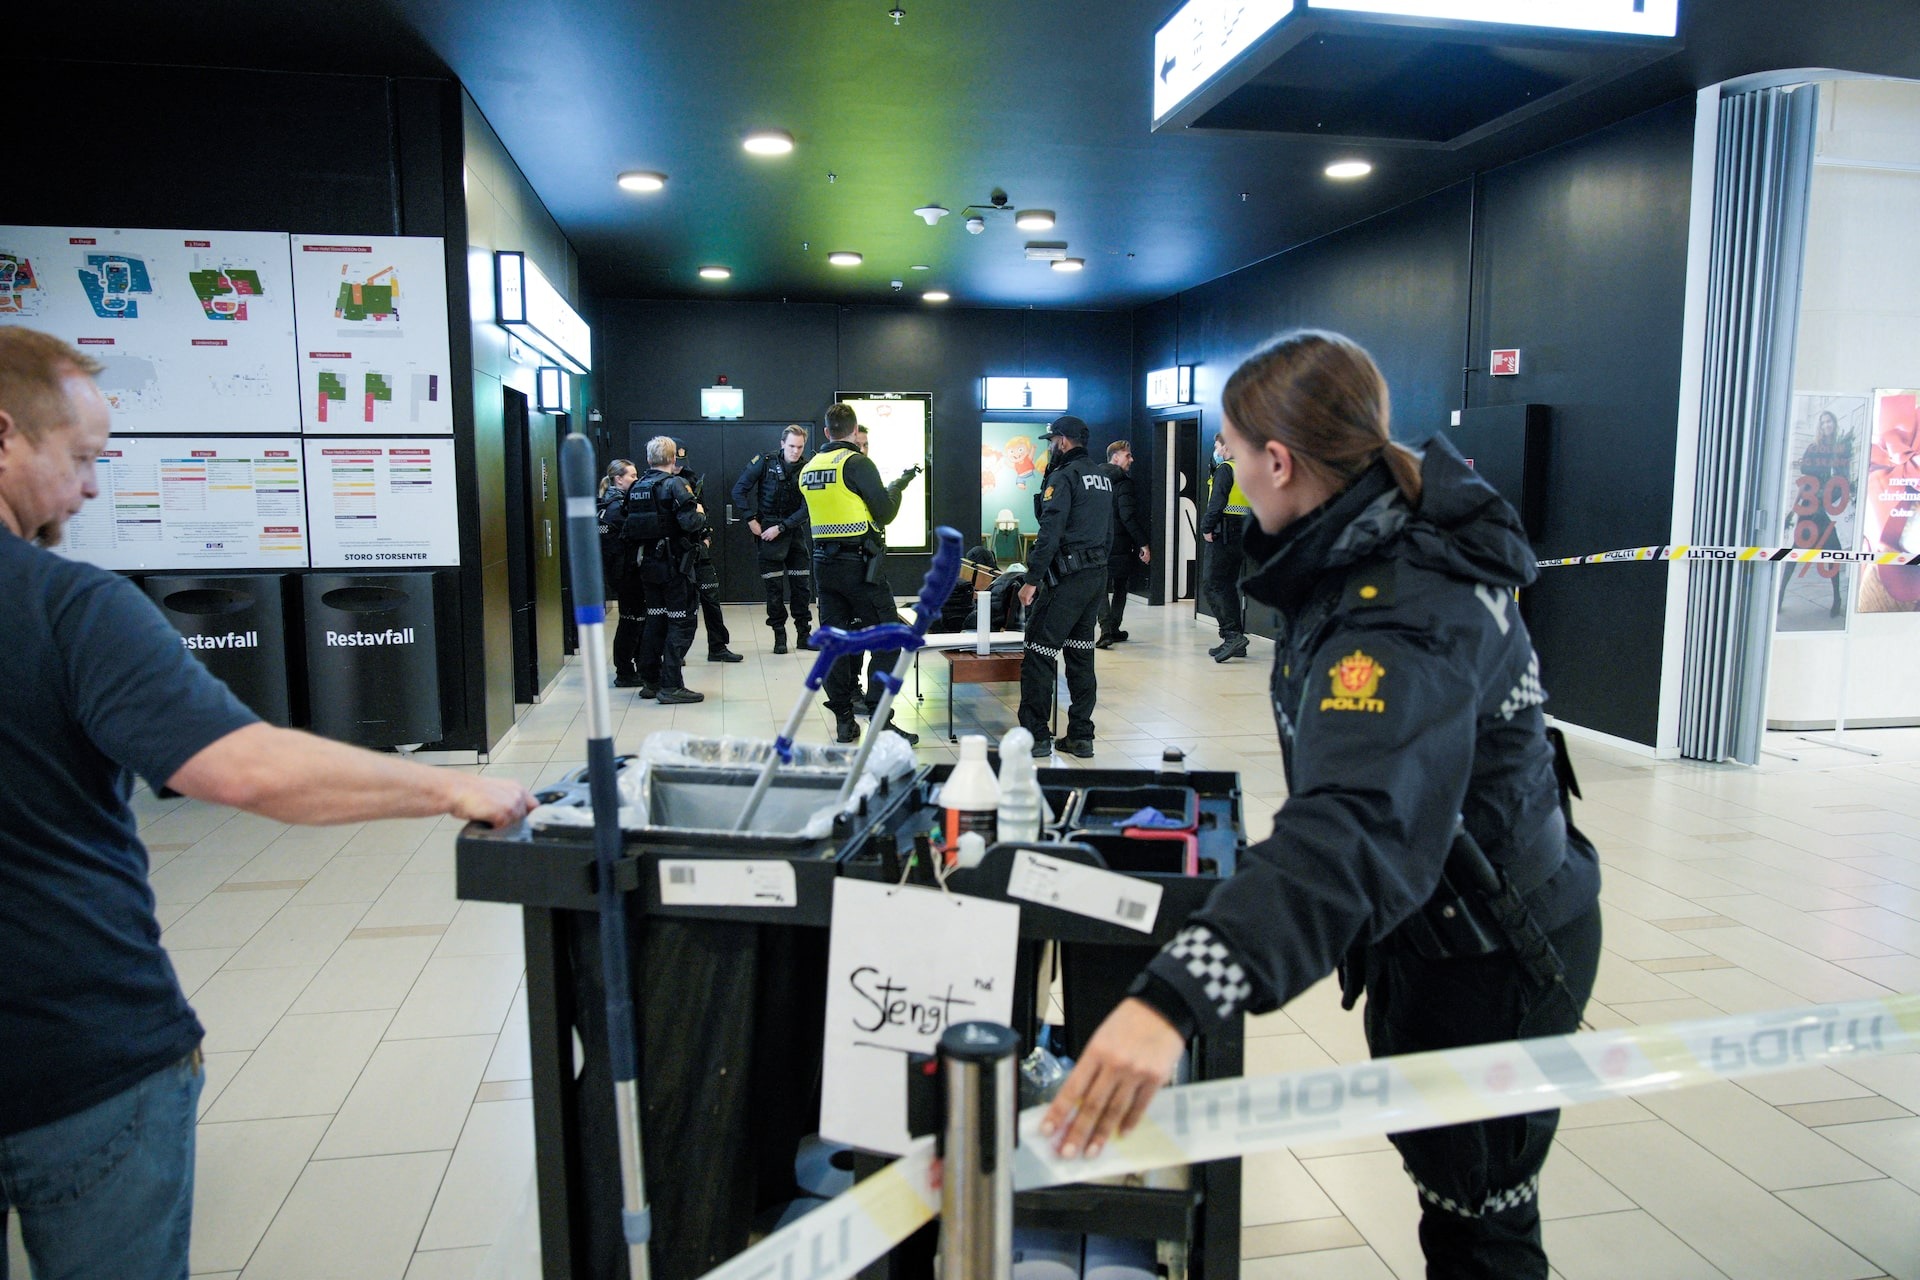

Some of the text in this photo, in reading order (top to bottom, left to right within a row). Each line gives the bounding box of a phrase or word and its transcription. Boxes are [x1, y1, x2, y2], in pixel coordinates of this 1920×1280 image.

[802, 470, 836, 486] POLITI
[1082, 474, 1113, 492] POLIT
[1888, 478, 1919, 488] merry
[630, 492, 651, 501] POLITI
[1793, 475, 1850, 516] 30
[1879, 489, 1920, 501] christma
[344, 553, 428, 561] STORO STORSENTER
[1605, 551, 1635, 559] POLITI
[1687, 550, 1737, 559] POLITI
[1821, 551, 1875, 561] POLITI
[180, 631, 258, 649] estavfall
[326, 627, 415, 647] Restavfall
[1320, 696, 1385, 713] POLITI
[850, 966, 975, 1034] Stengt
